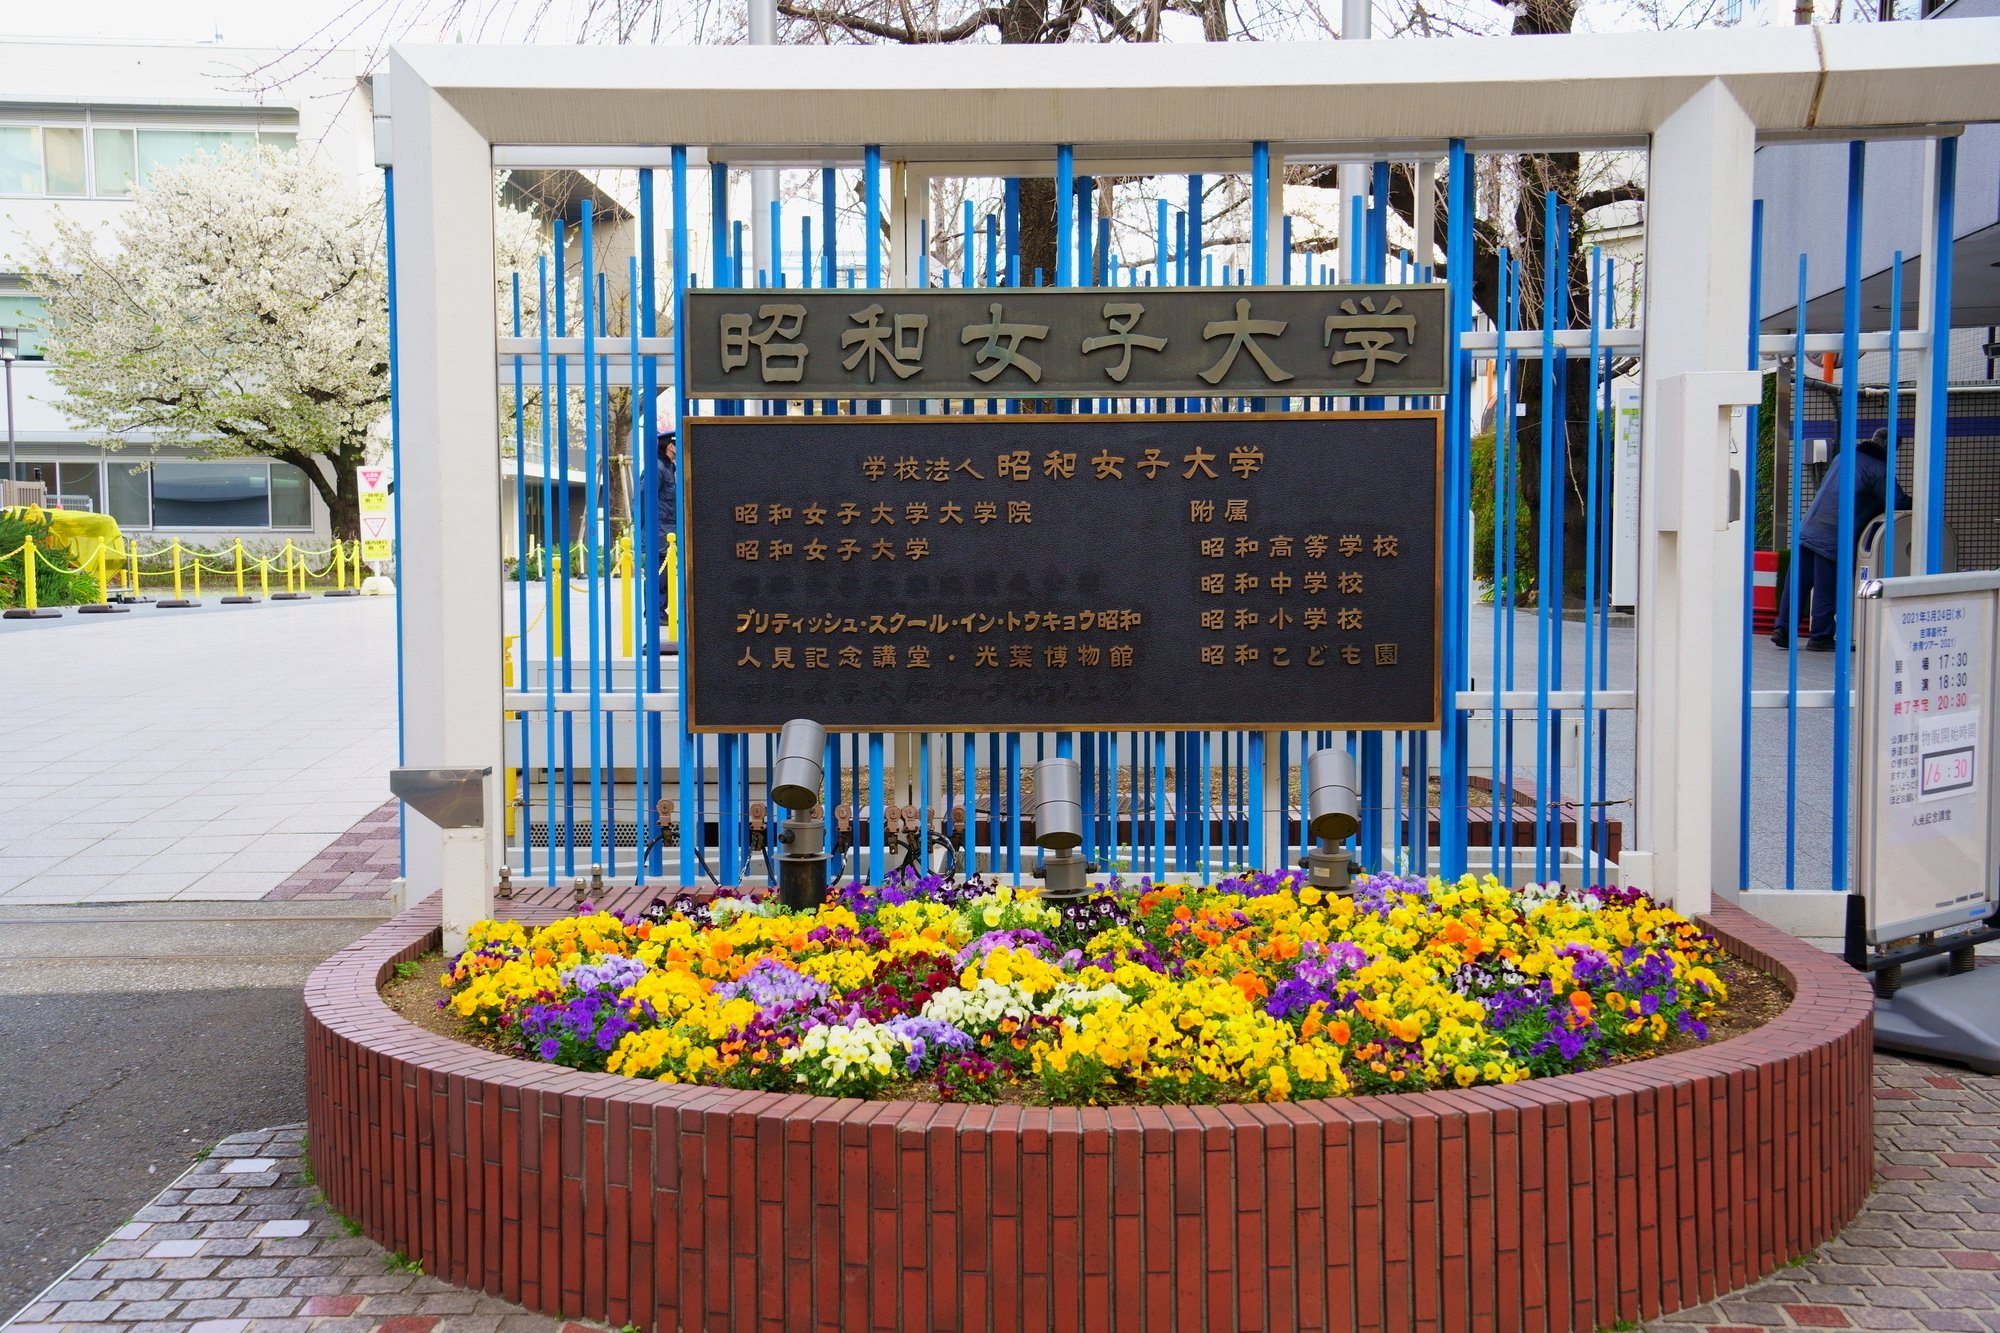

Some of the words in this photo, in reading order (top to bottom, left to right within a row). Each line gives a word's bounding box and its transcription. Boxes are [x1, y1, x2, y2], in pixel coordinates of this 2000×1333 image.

[719, 298, 1418, 384] 昭和女子大学
[734, 500, 1033, 527] 昭和女子大学大学院
[1188, 498, 1250, 524] 附属
[734, 537, 930, 562] 昭和女子大学
[1199, 533, 1400, 560] 昭和高等学校
[1199, 570, 1364, 596] 昭和中学校
[1199, 607, 1364, 632] 昭和小学校
[1199, 642, 1398, 668] 昭和こども園
[1939, 652, 1968, 670] 17:30
[1939, 672, 1968, 690] 18:30
[1938, 692, 1967, 711] 20:30
